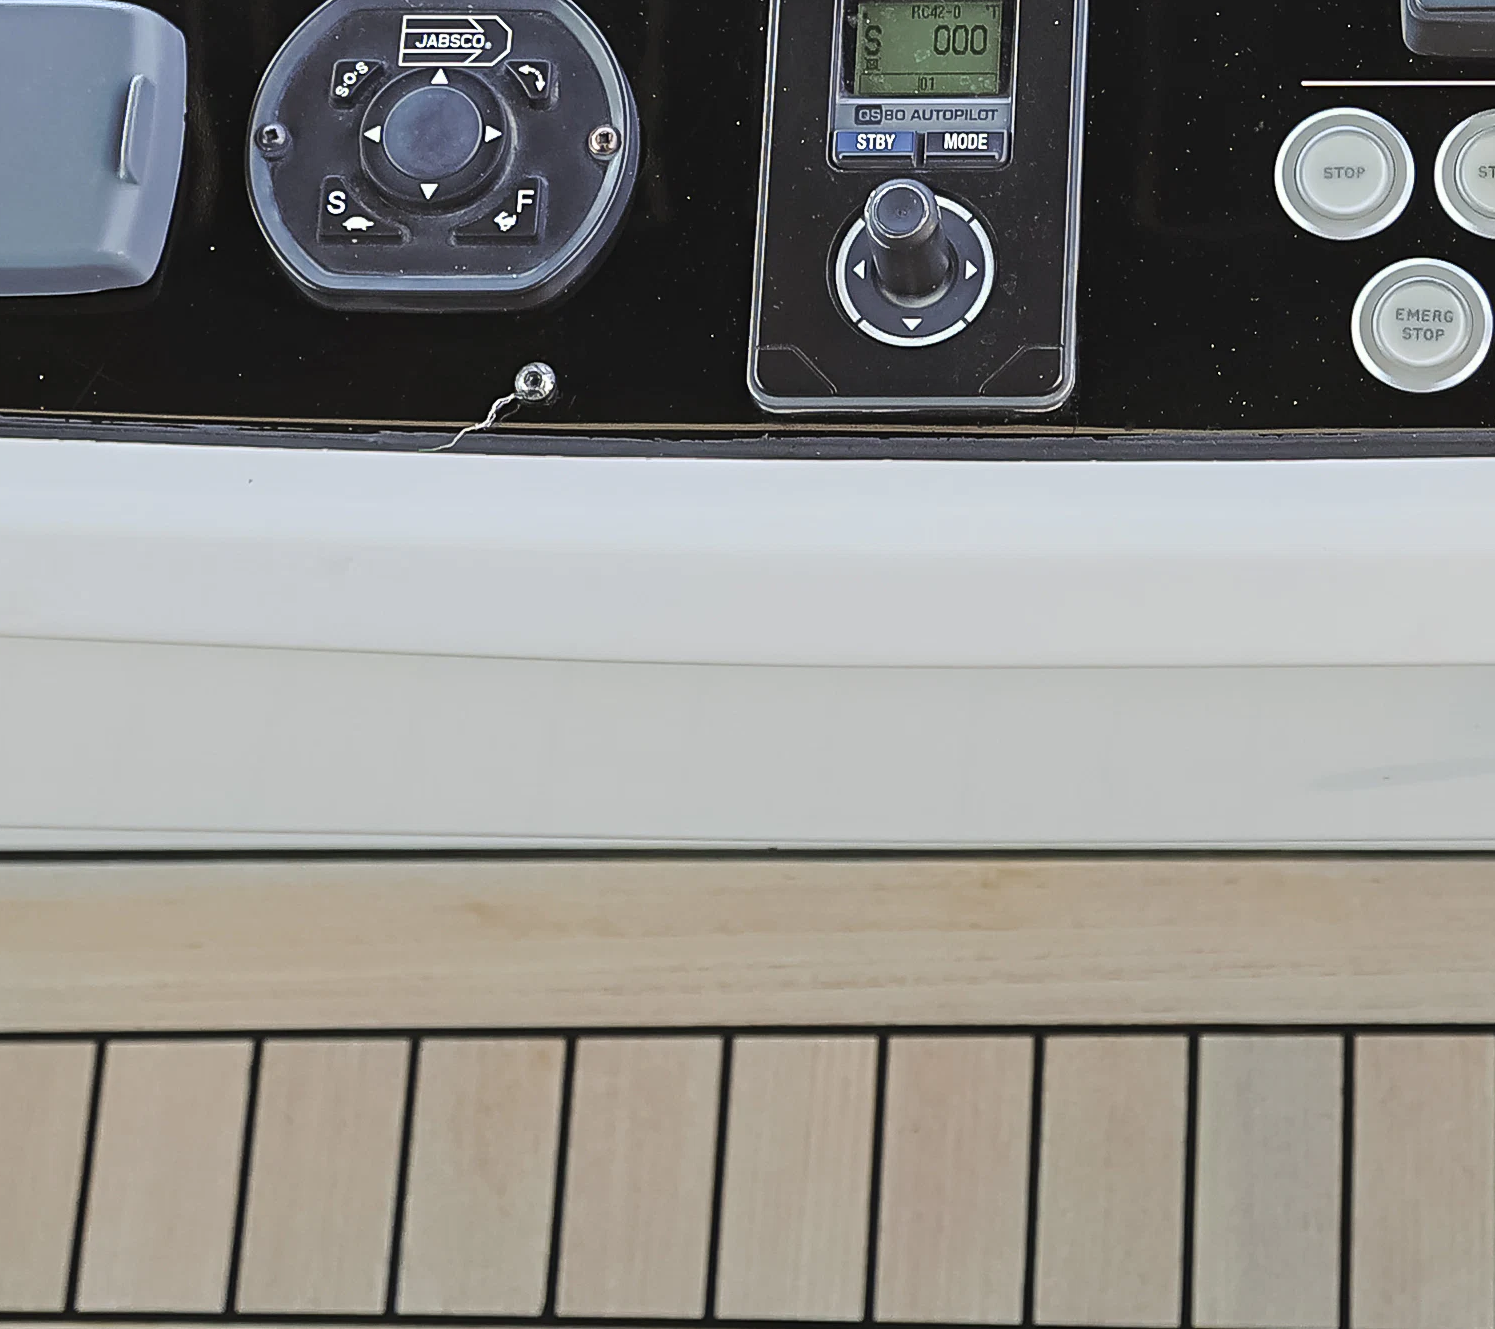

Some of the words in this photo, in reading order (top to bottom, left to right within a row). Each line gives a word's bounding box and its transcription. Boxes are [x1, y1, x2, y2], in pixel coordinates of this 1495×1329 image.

[415, 35, 485, 49] JABSCO
[864, 25, 882, 56] S
[934, 25, 988, 56] 000
[910, 109, 998, 121] AUTOPILOT
[856, 134, 895, 149] STBY
[944, 134, 988, 149] MODE
[1323, 167, 1365, 179] STOP
[327, 191, 346, 214] S
[517, 190, 534, 213] F
[1396, 308, 1454, 323] EMERG
[1402, 327, 1445, 341] STOP
